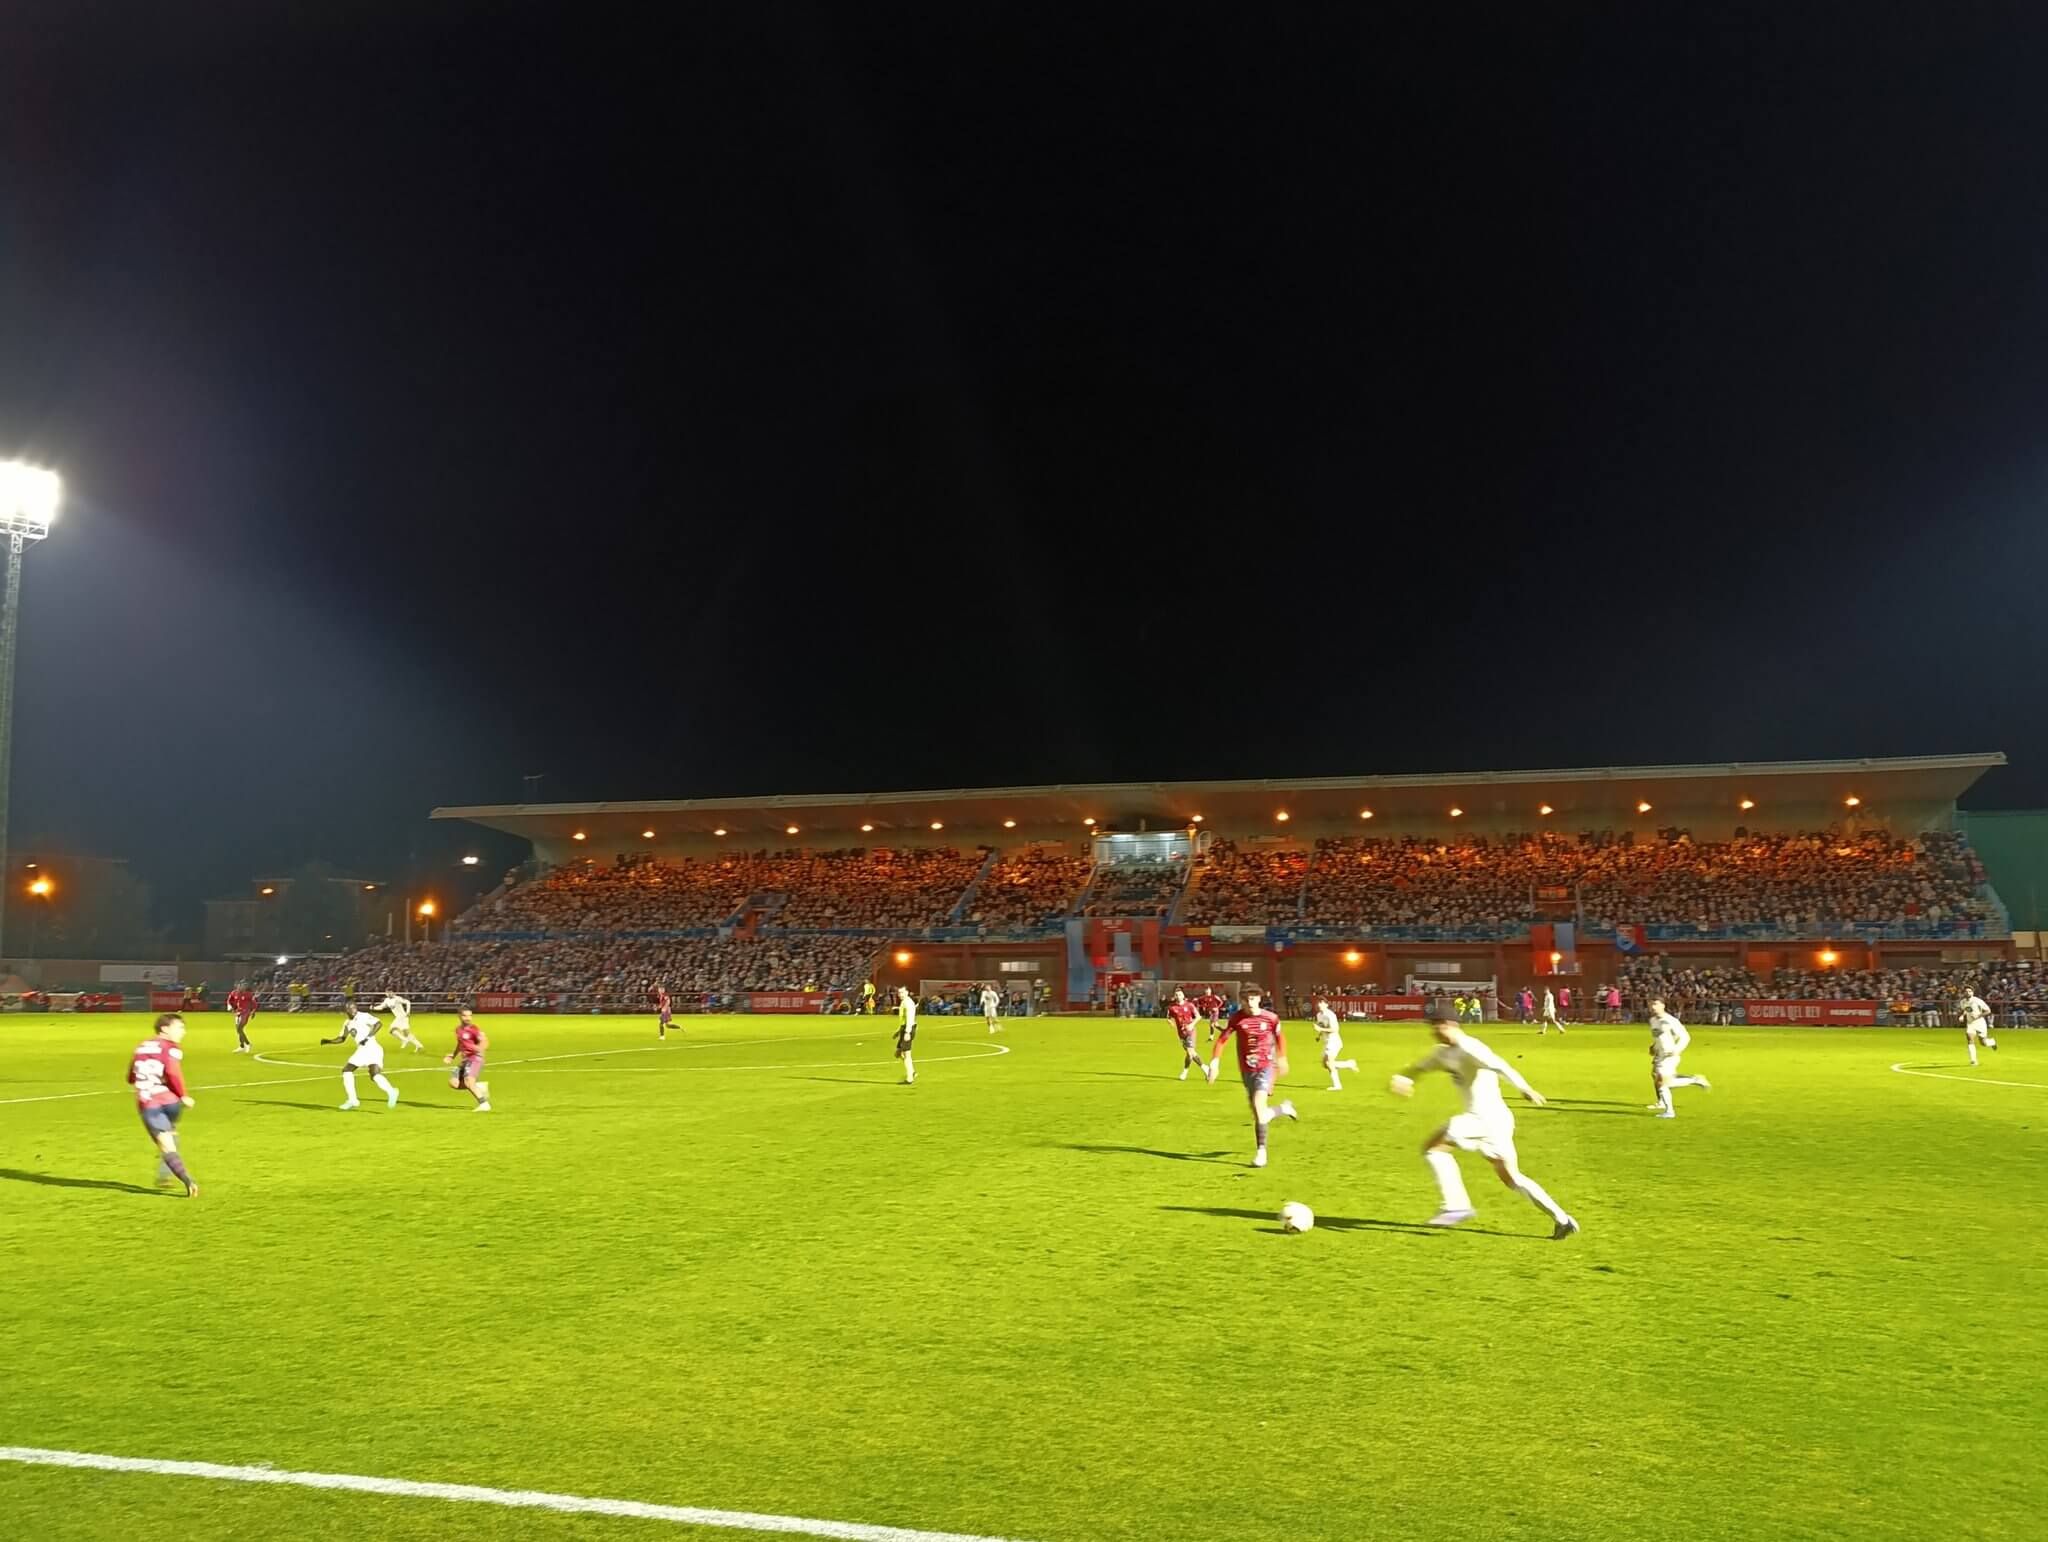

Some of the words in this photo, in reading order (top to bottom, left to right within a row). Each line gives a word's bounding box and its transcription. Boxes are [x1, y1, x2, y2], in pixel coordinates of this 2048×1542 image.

[1763, 1005, 1786, 1018] COPA
[1787, 1005, 1802, 1018] DEL
[1805, 1005, 1821, 1018] REY
